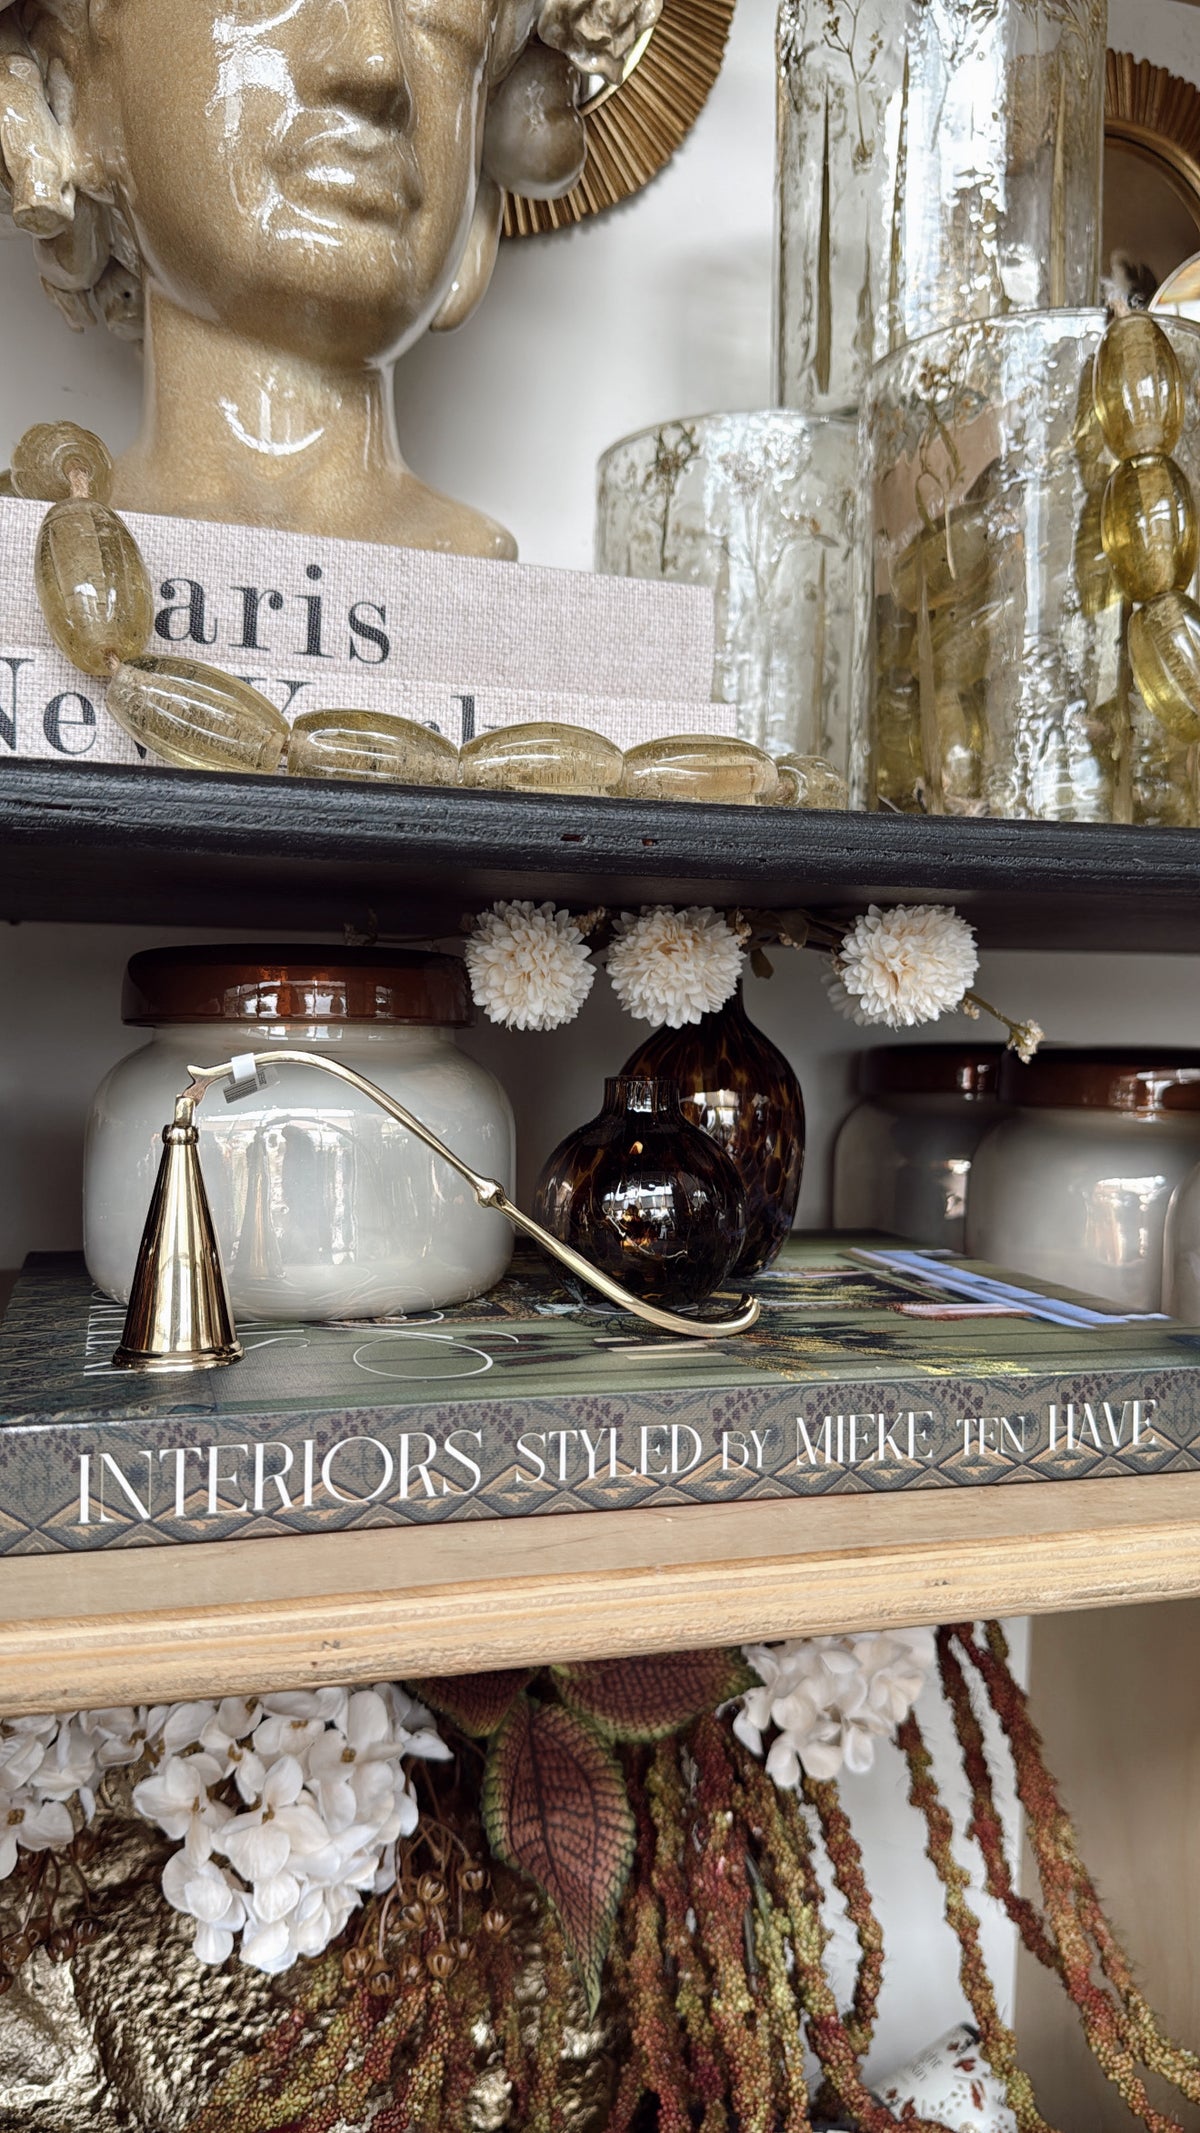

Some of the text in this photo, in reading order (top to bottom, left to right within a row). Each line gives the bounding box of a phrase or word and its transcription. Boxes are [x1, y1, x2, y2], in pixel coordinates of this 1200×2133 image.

[154, 563, 391, 665] aris
[78, 1399, 1158, 1524] INTERIORS STYLED BY MIEKE TEN HAVE
